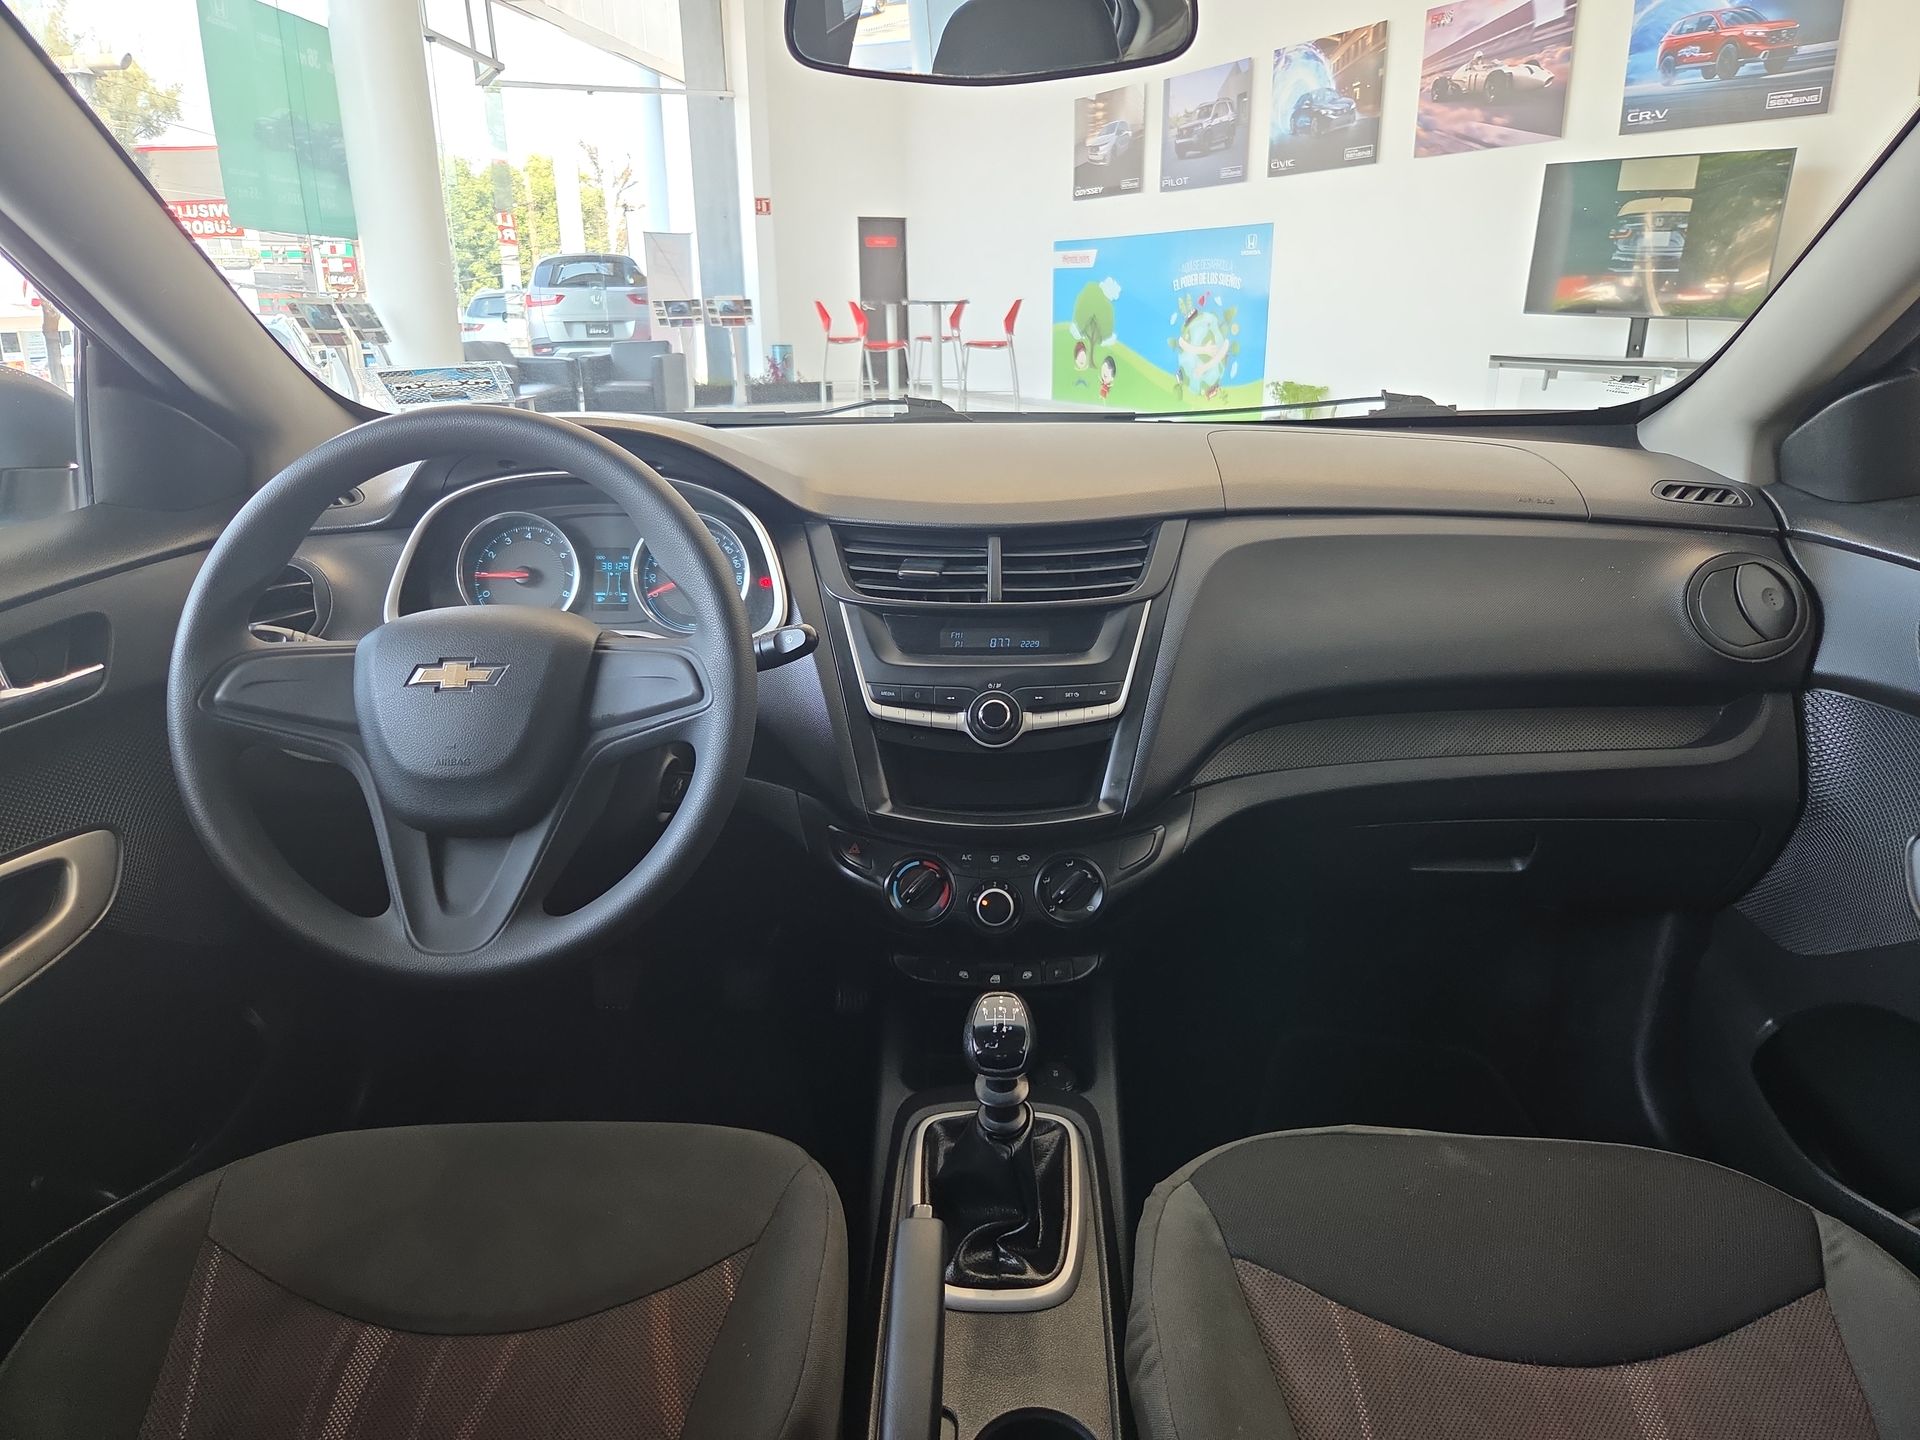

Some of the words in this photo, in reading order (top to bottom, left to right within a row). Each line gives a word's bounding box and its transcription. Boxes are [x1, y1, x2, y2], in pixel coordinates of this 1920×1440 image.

[1769, 95, 1819, 106] SENSING
[1627, 109, 1669, 122] CR-V
[1270, 159, 1295, 168] CIVIC
[1161, 176, 1190, 187] PILOT
[1074, 186, 1104, 197] ODYSSEY
[505, 537, 512, 545] 3
[544, 537, 552, 545] 5
[722, 542, 734, 554] 140
[488, 550, 497, 559] 2
[602, 562, 629, 570] 38129
[732, 555, 742, 569] 160
[649, 573, 657, 583] 20
[735, 572, 743, 586] 180
[482, 590, 491, 598] 0
[562, 590, 570, 598] 8
[1020, 640, 1040, 648] 2229
